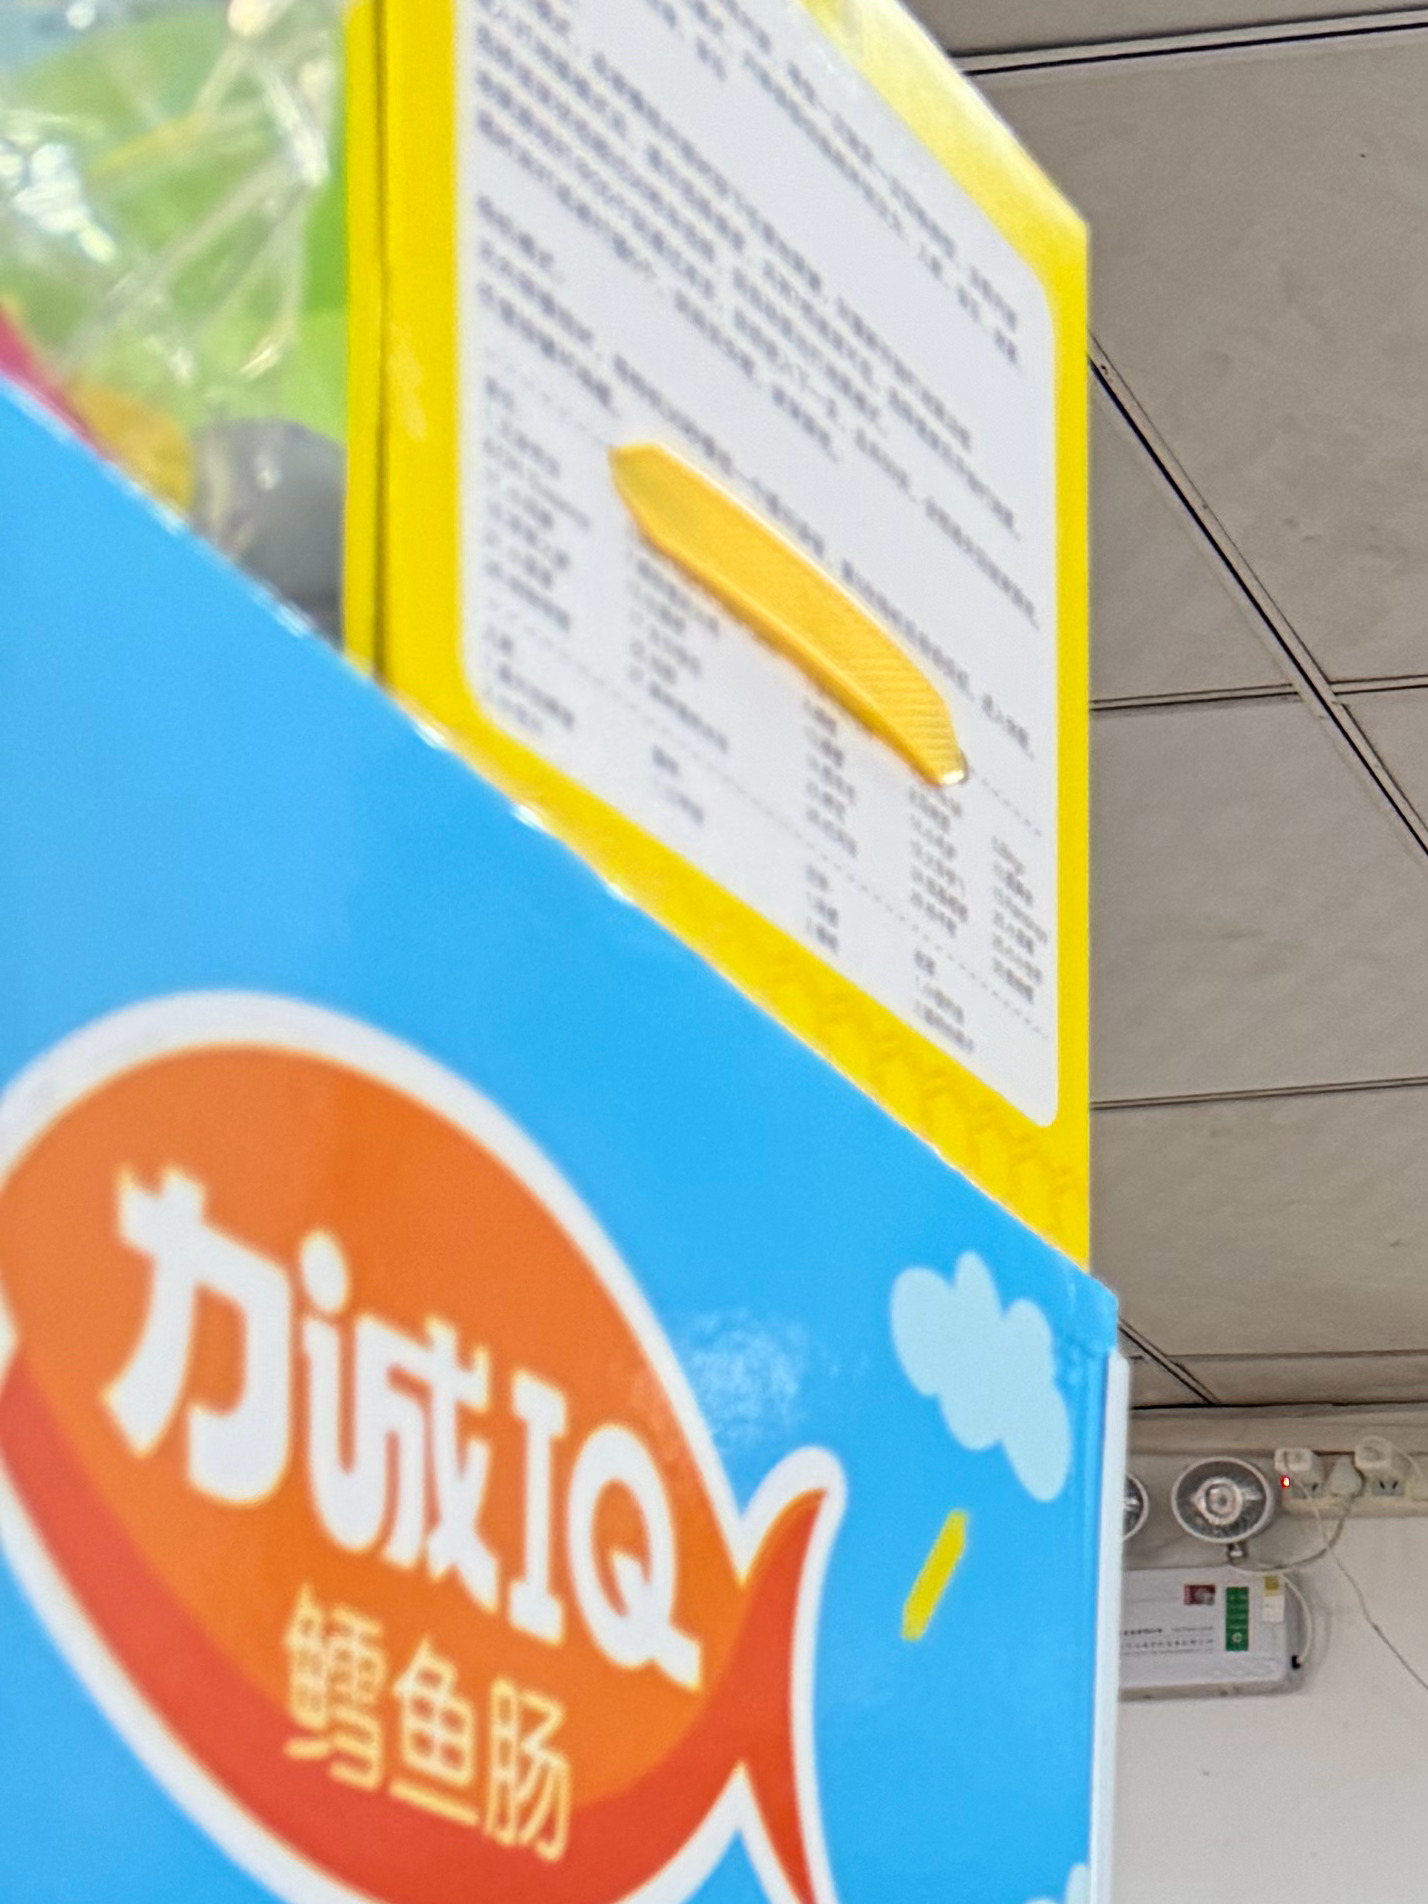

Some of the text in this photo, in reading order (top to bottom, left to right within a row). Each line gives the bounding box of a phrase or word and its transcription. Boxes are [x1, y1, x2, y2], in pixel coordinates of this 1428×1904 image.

[103, 1165, 703, 1692] 力诚IQ
[283, 1583, 573, 1866] 鳕鱼肠
